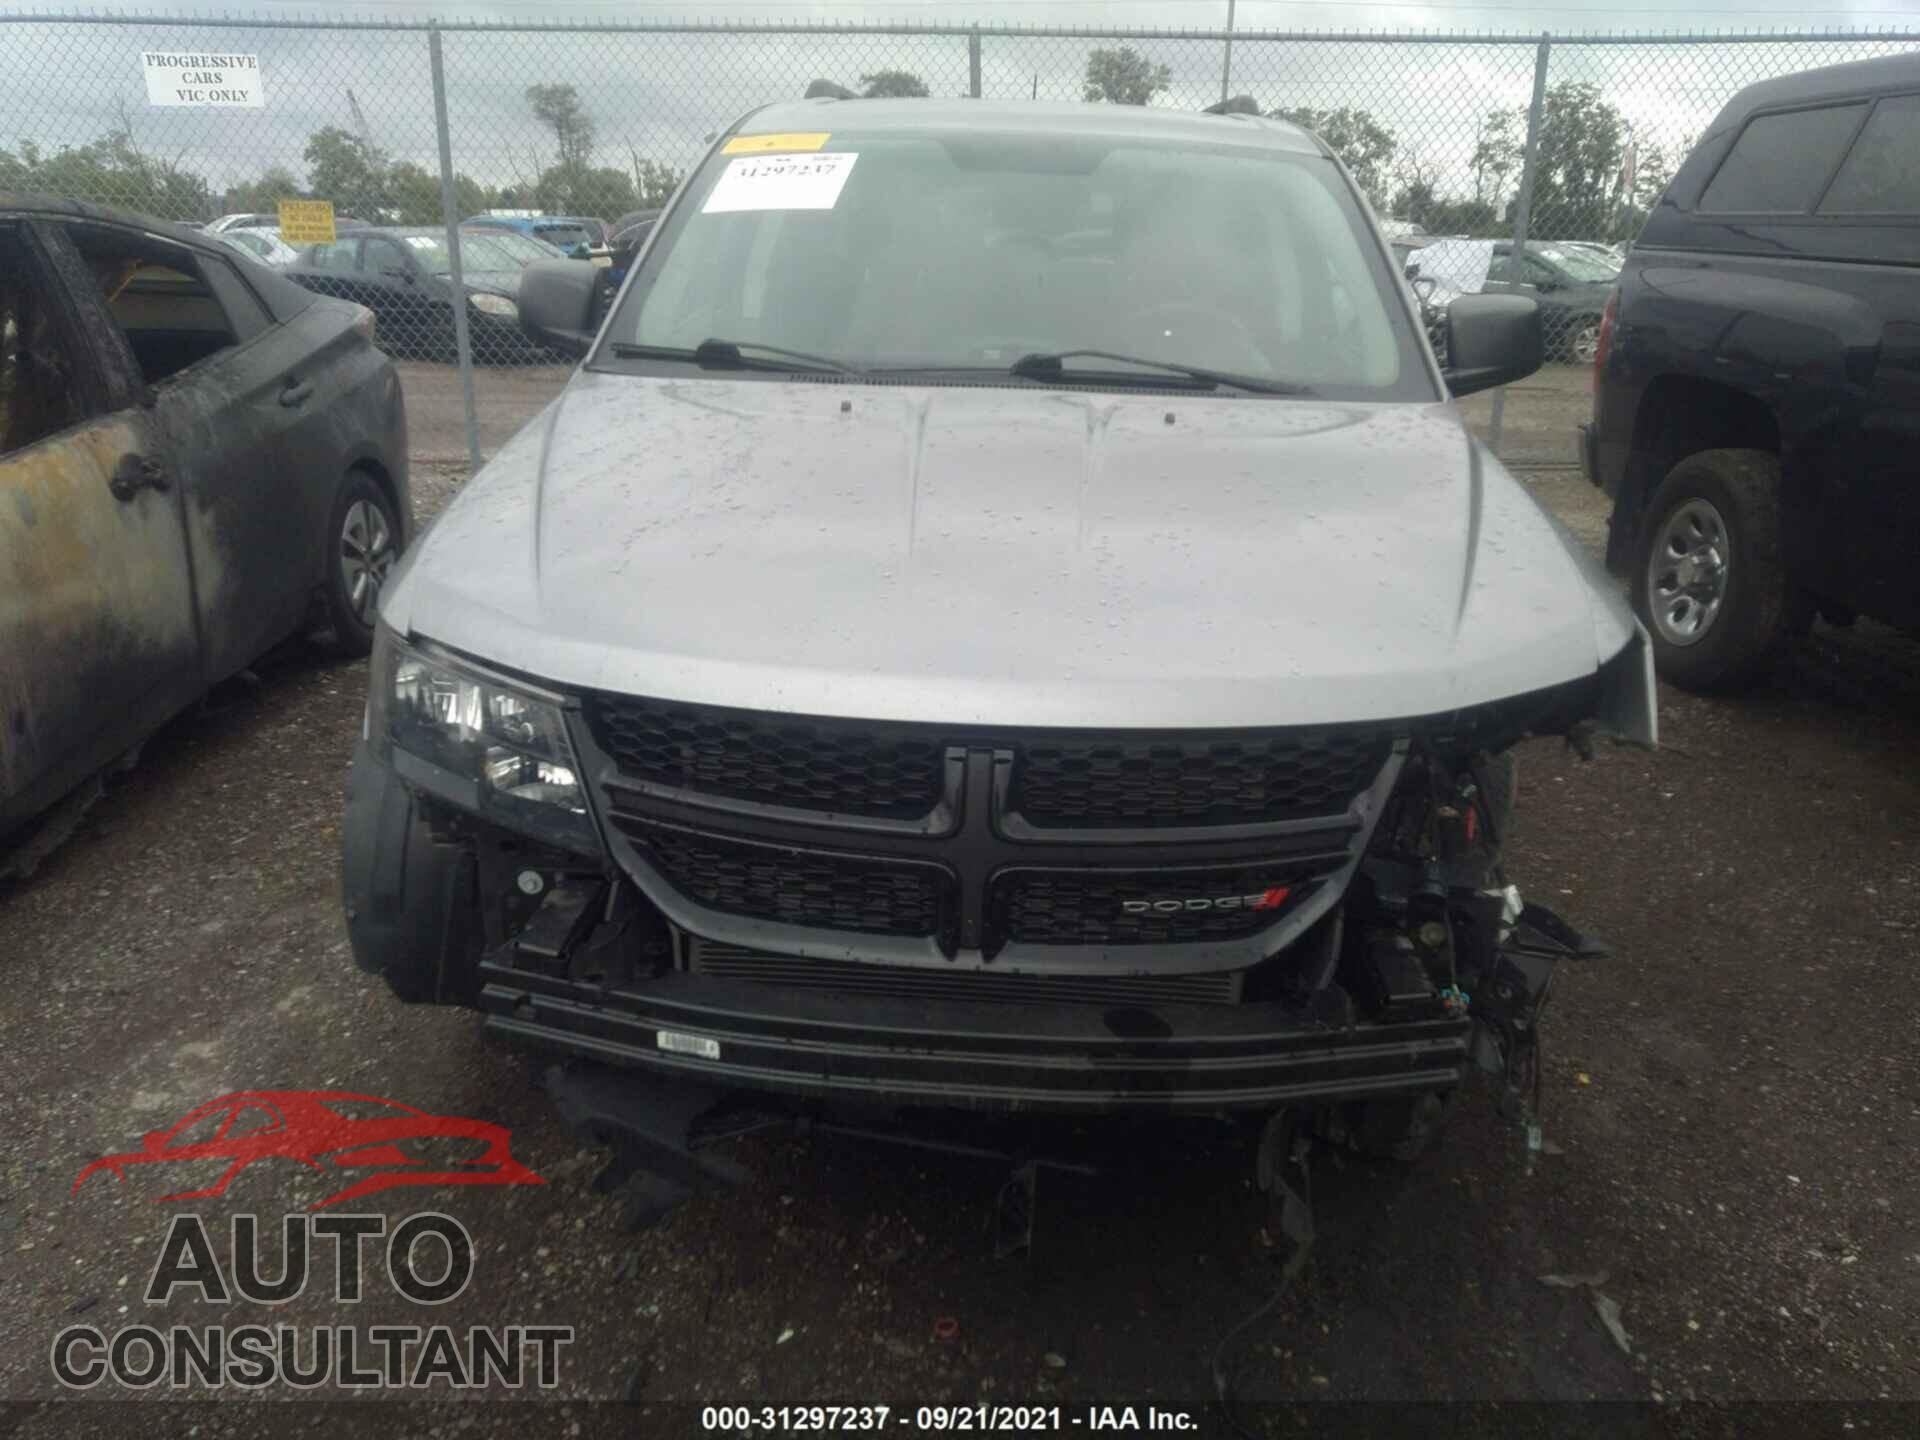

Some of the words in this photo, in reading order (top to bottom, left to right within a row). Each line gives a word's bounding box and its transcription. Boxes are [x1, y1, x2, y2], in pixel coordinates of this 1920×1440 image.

[145, 53, 257, 69] PROGRESSIVE
[182, 71, 223, 84] CARS
[176, 89, 205, 102] VIC
[208, 89, 249, 102] ONLY
[1123, 895, 1269, 912] DODGE
